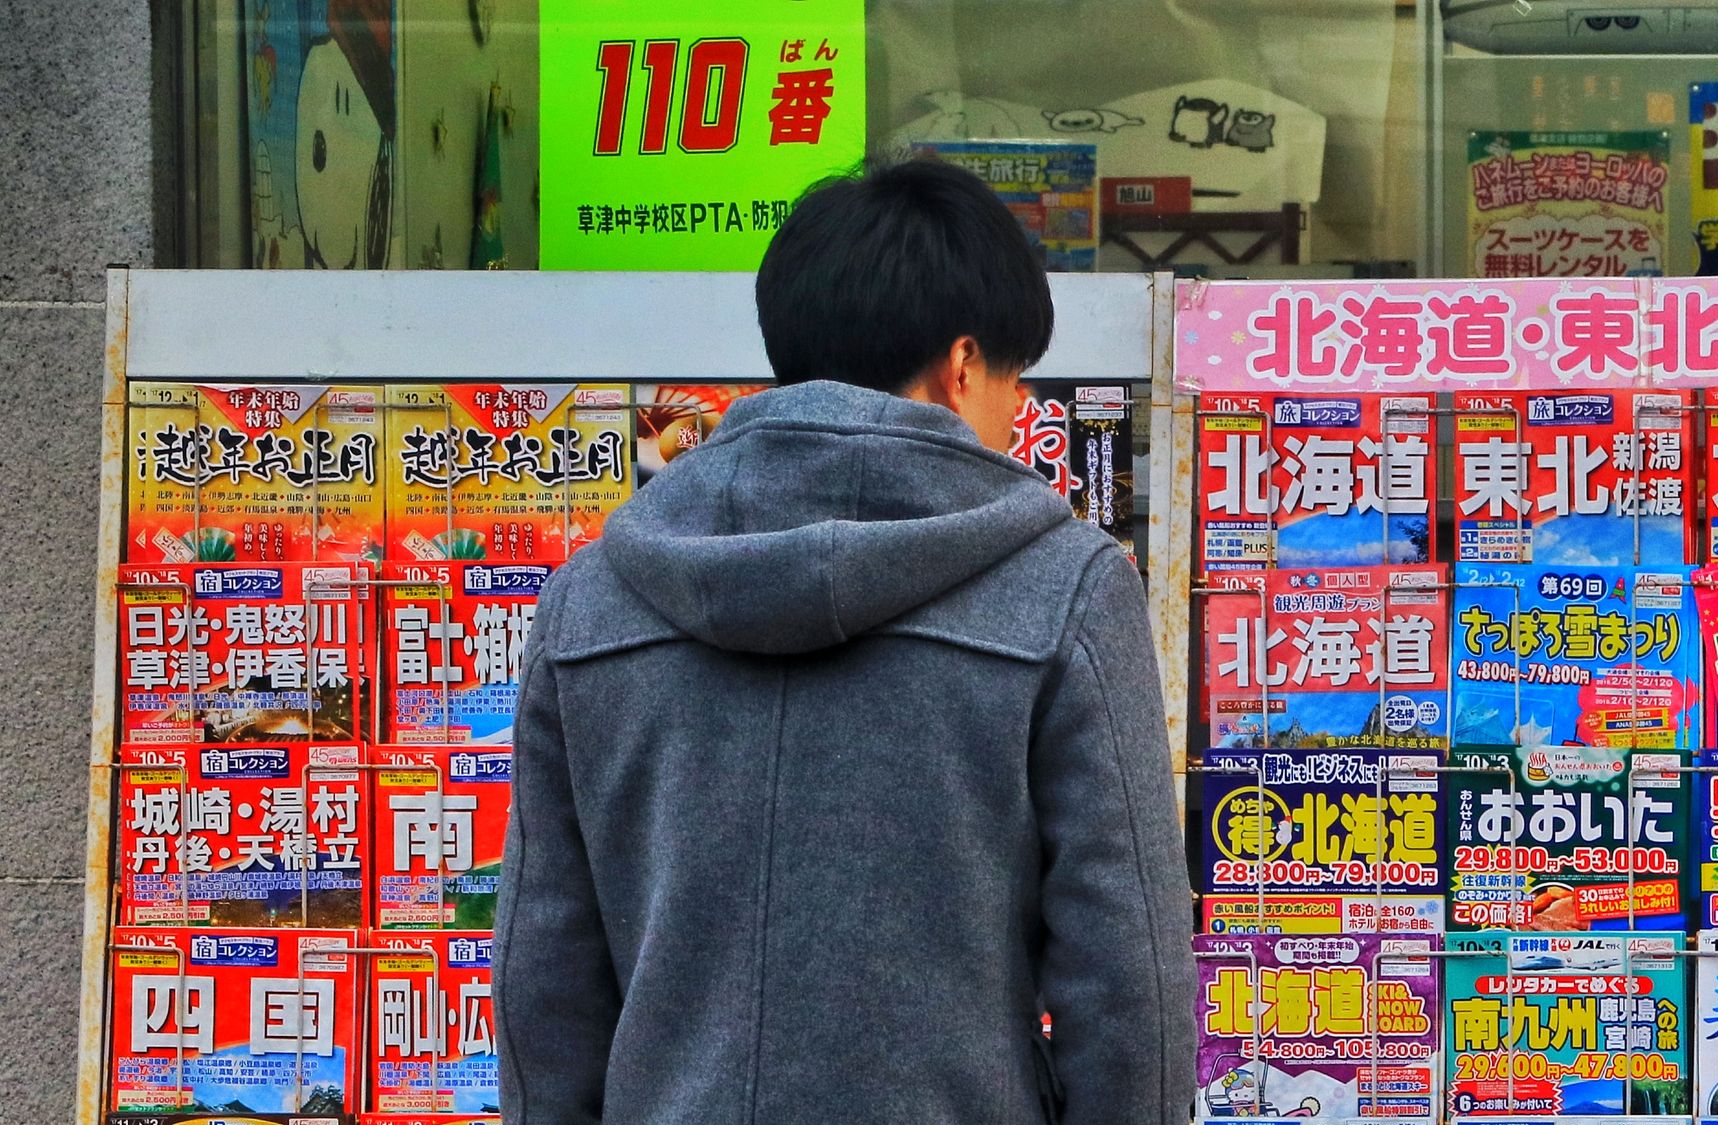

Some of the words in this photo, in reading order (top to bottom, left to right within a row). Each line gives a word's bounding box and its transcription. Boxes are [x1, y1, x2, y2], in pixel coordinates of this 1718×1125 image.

[779, 40, 838, 62] ばん
[593, 36, 749, 156] 110
[769, 68, 834, 146] 番
[577, 199, 795, 237] 草津中学校区PTA・防犯
[1485, 228, 1648, 252] スーツケースを
[1484, 255, 1628, 278] 無料レンタル
[227, 391, 300, 410] 年末年始
[245, 411, 281, 430] 特集
[473, 391, 547, 410] 年末年始
[491, 411, 529, 430] 特集
[151, 424, 377, 488] 越年お正月
[398, 424, 623, 490] 越年お正月
[1101, 433, 1114, 526] お正月におすすめの
[1208, 435, 1428, 516] 北海道
[1275, 595, 1382, 614] 観光周遊プラン
[1541, 575, 1602, 596] 第69回
[1218, 617, 1435, 689] 北海道
[1459, 604, 1680, 661] さっぽろ雪まつり
[1292, 793, 1437, 866] 北海道
[1479, 789, 1673, 844] おおいた
[1206, 967, 1365, 1037] 北海道
[1489, 977, 1639, 995] レンタカーでめぐる
[1601, 998, 1655, 1023] 鹿児島
[130, 976, 335, 1058] 四国
[1453, 998, 1598, 1052] 南九州
